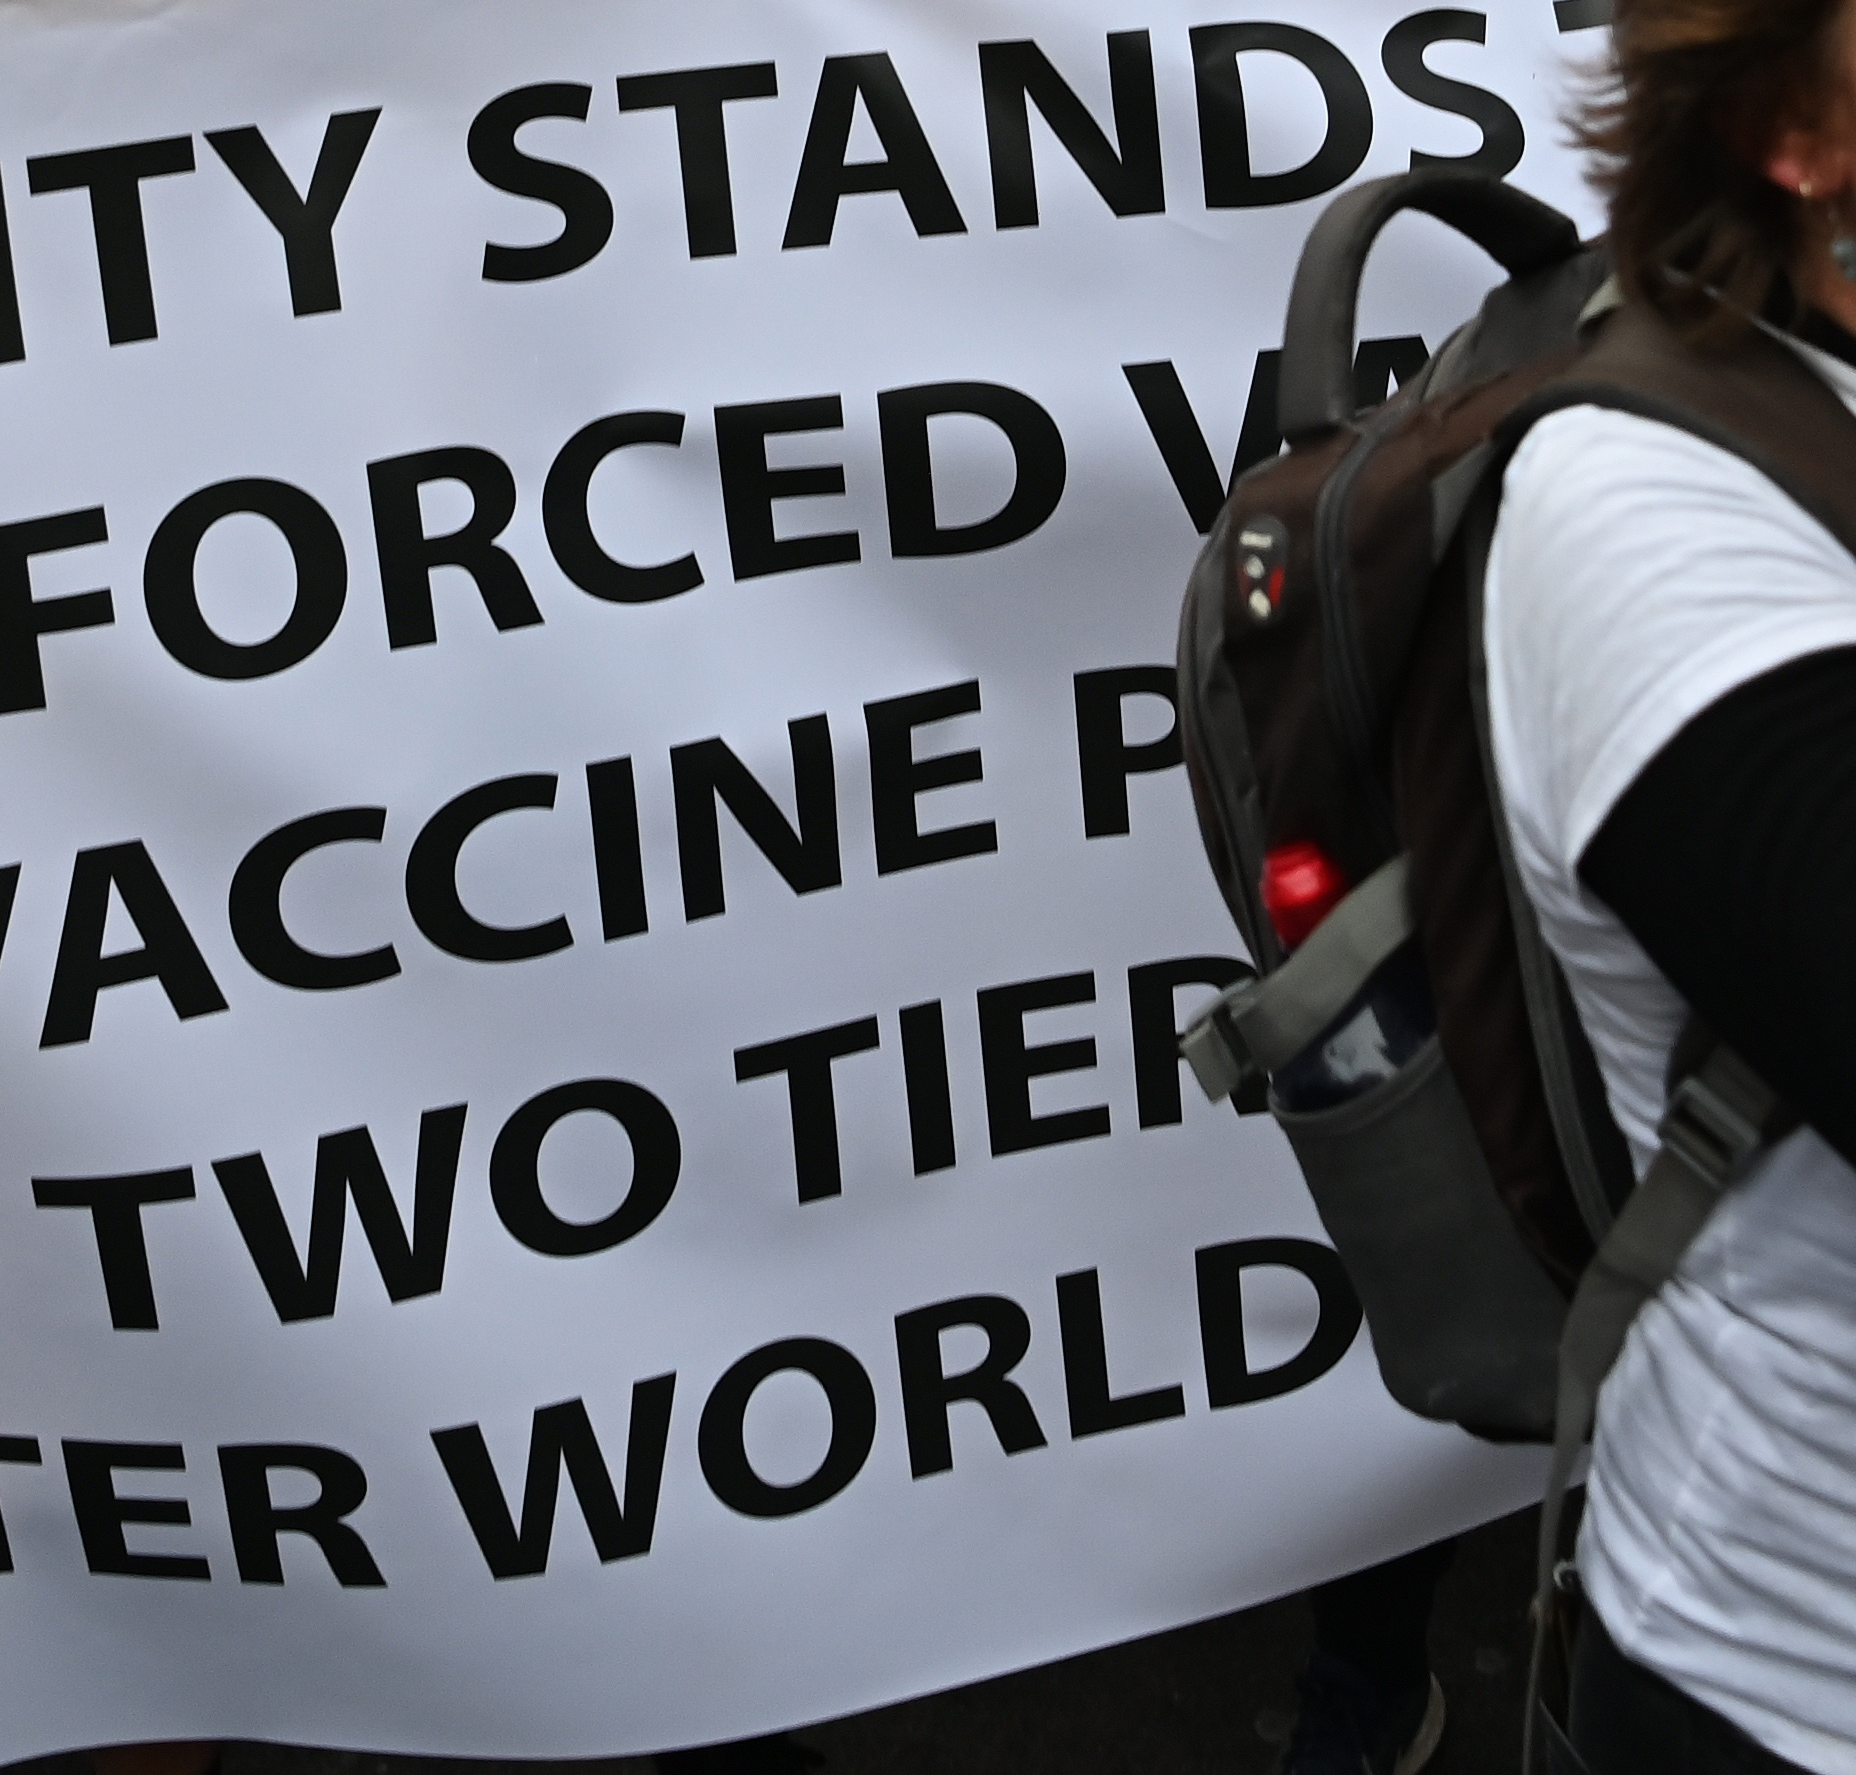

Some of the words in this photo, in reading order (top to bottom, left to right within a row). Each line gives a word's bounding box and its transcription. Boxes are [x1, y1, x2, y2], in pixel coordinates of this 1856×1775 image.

[468, 7, 1526, 281] STANDS
[32, 1080, 681, 1330] TWO
[431, 1237, 1365, 1580] WORLD
